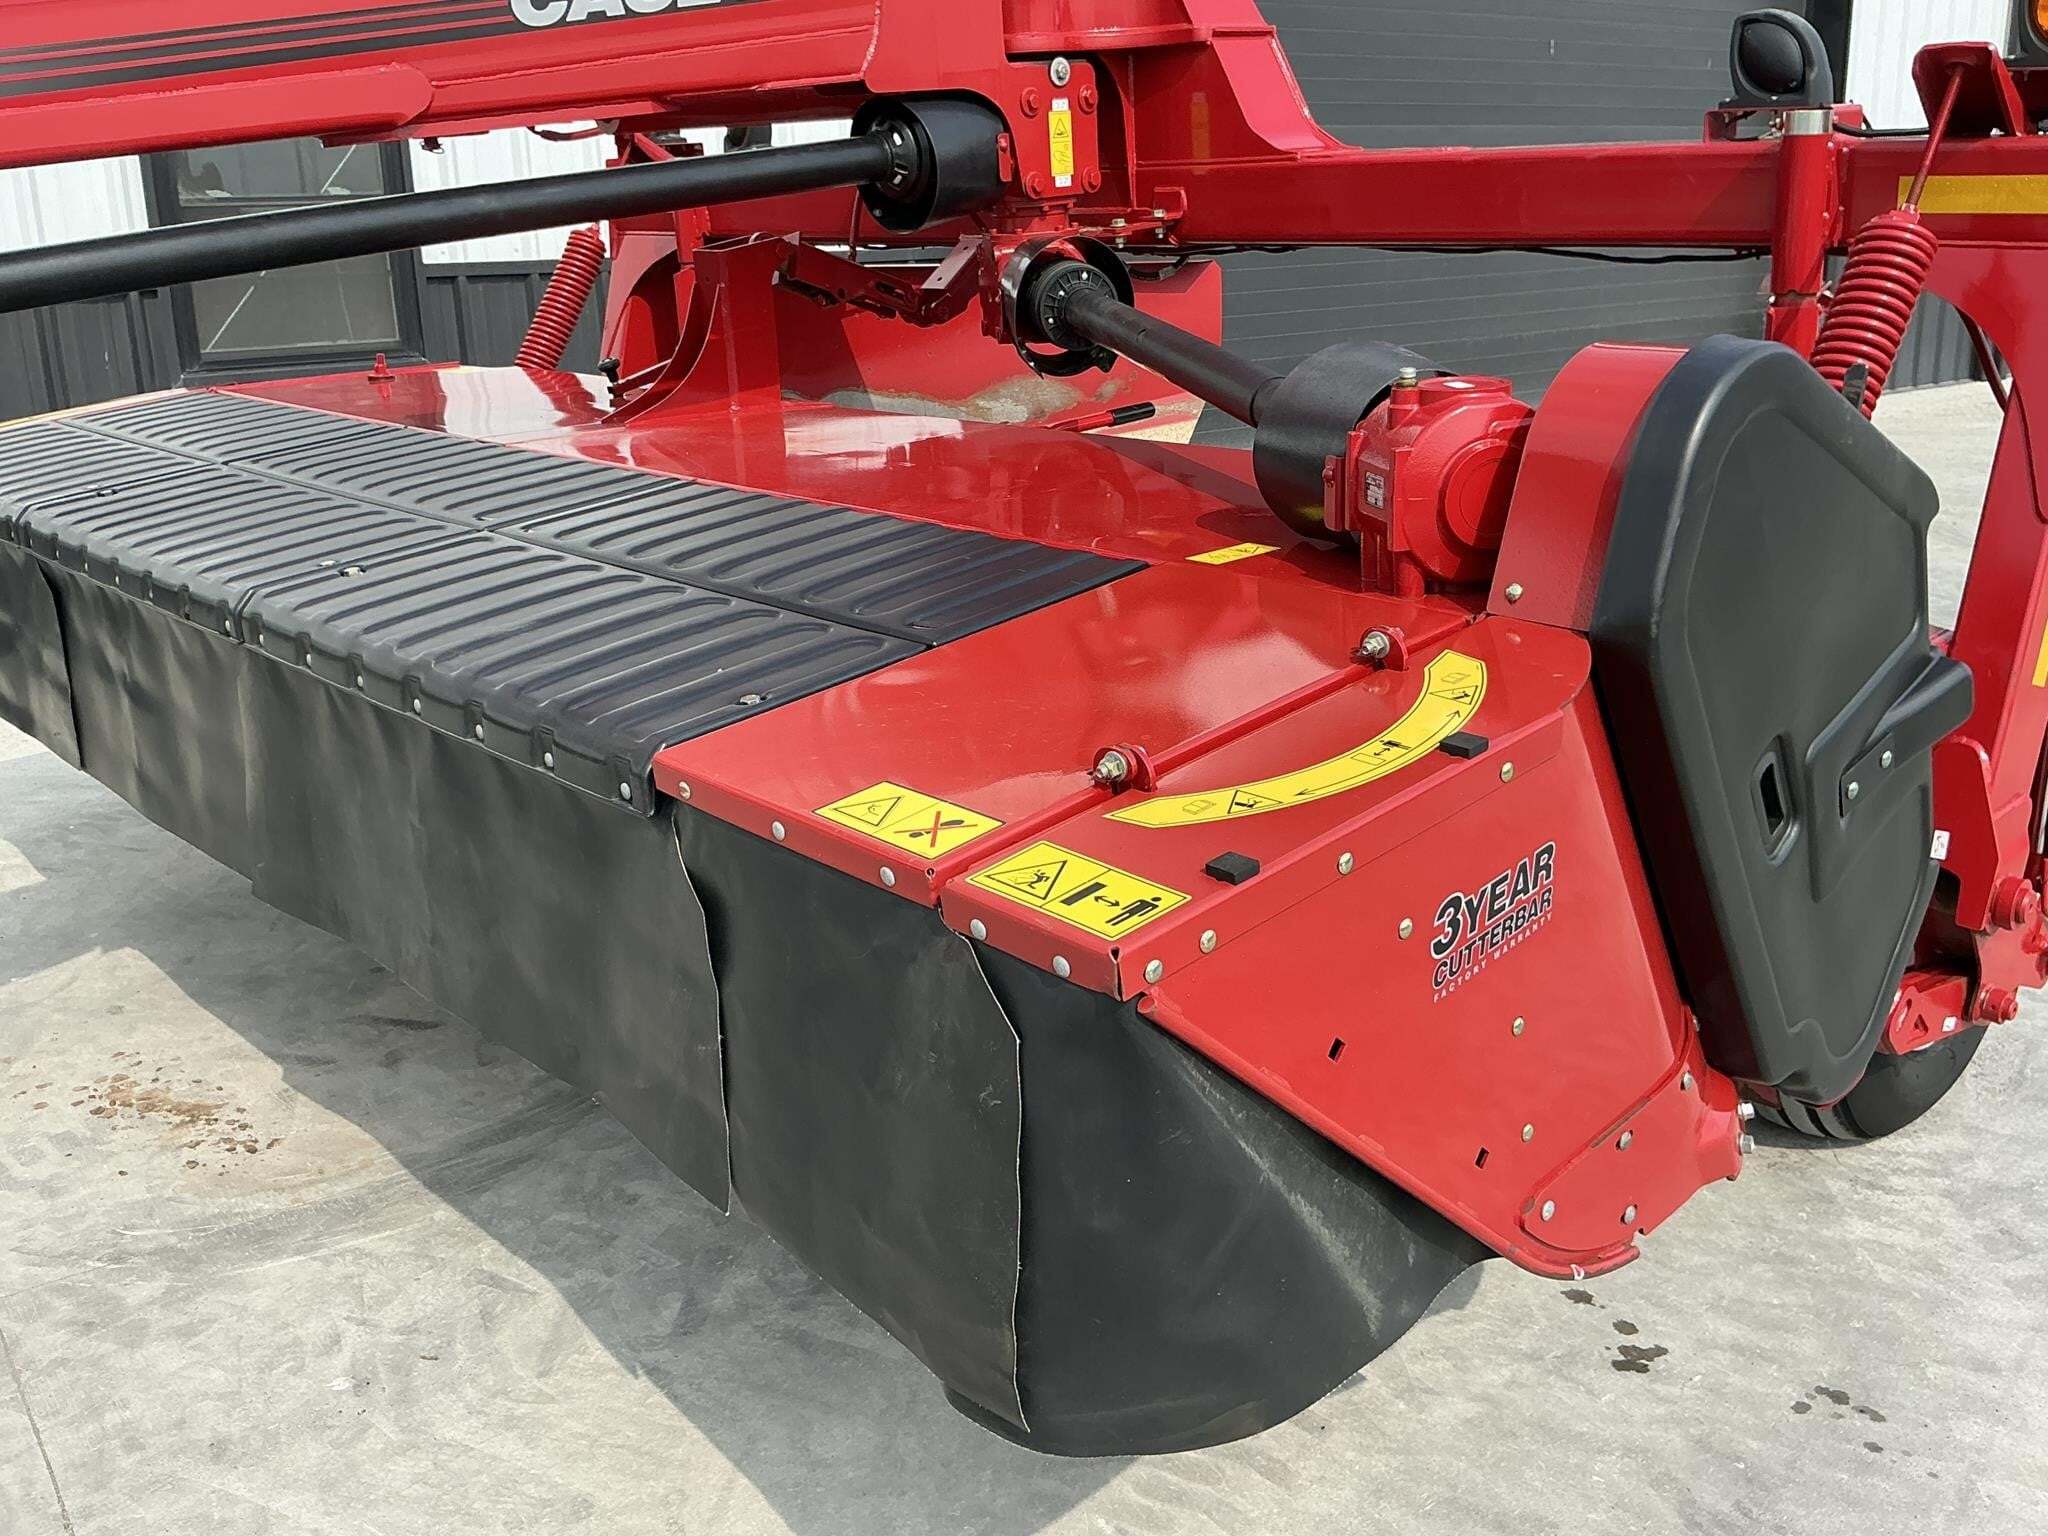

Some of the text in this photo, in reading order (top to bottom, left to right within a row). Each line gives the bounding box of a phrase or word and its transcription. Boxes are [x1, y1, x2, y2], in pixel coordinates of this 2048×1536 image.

[1432, 885, 1553, 990] CUTTERBAR
[1433, 911, 1553, 1003] FACTORY WARRANTY
